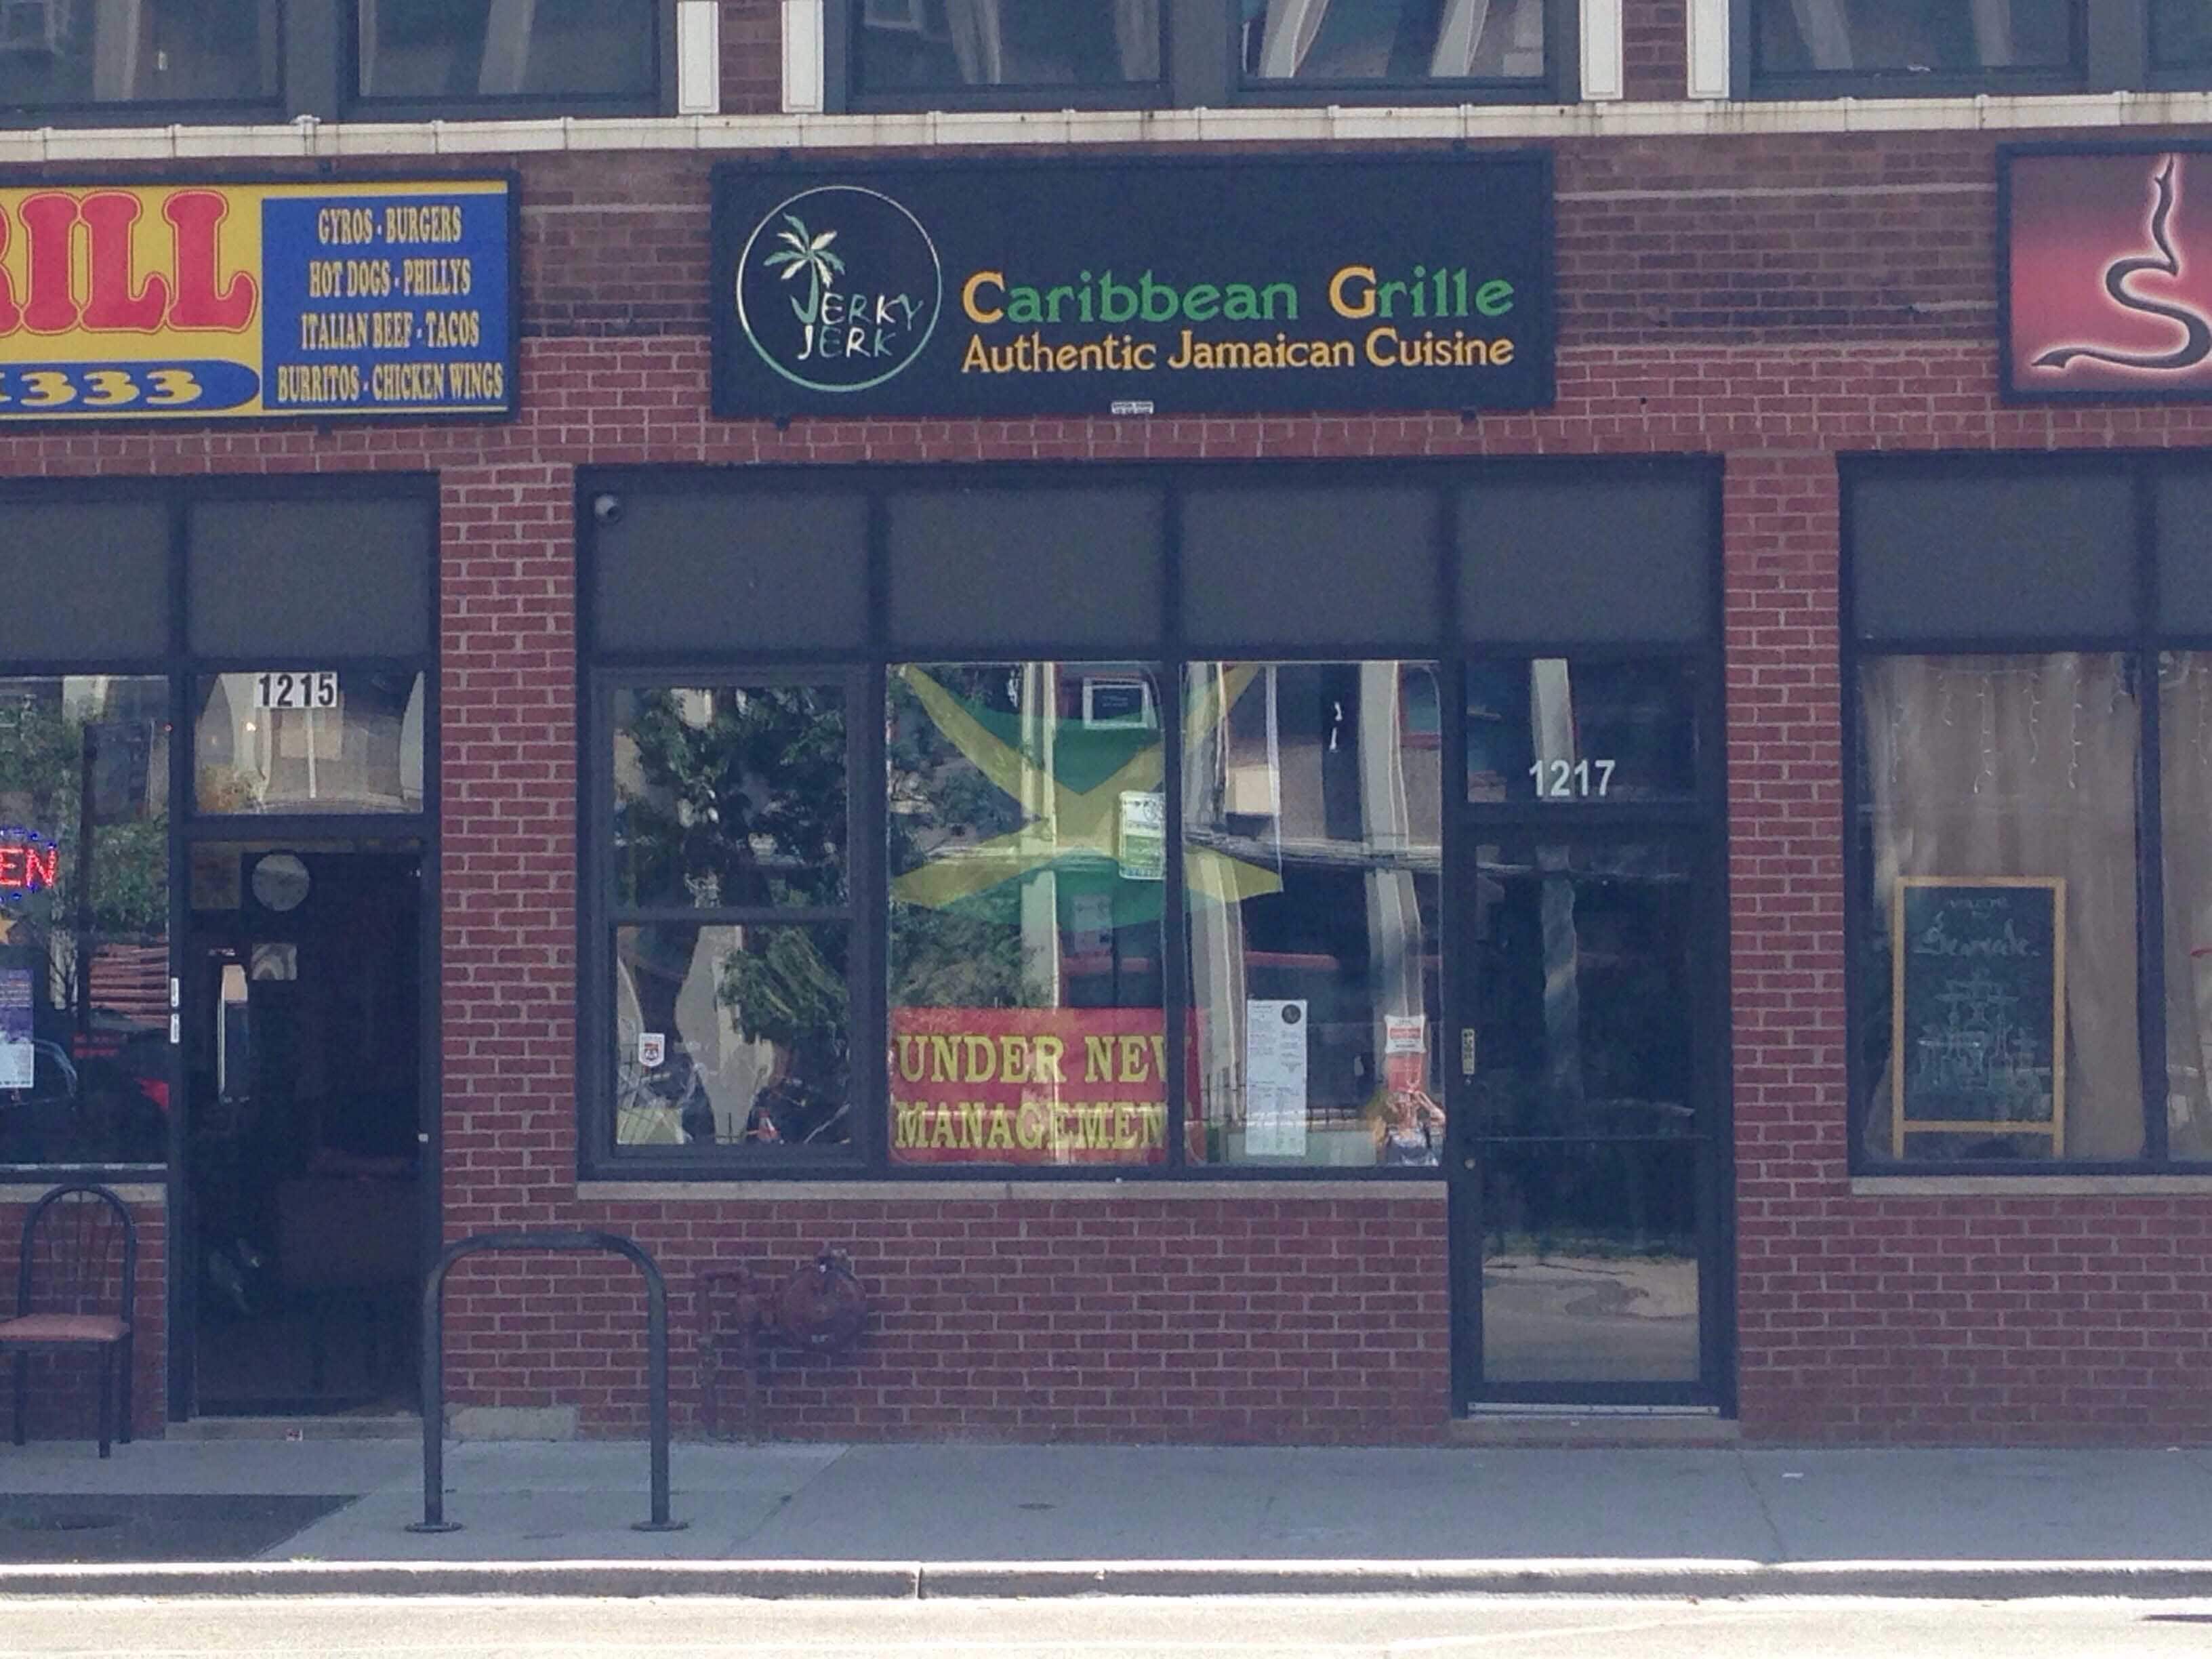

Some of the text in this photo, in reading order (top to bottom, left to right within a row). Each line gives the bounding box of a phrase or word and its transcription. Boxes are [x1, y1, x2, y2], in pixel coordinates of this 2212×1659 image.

[318, 205, 462, 245] GYROS BURGERS
[0, 190, 258, 337] ILL
[309, 258, 471, 298] HOT DOGS PHILLYS
[962, 264, 1515, 324] Caribbean Grille
[301, 310, 479, 350] ITALIAN BEEF TACOS
[798, 324, 897, 360] JERK
[961, 326, 1515, 373] Authentic Jamaican Cuisine
[0, 369, 203, 405] 333
[277, 362, 504, 403] BURRITOS CHICKEN WINGS
[259, 674, 334, 707] 1215
[1529, 759, 1616, 797] 1217
[895, 1033, 1067, 1084] UNDER
[894, 1101, 1168, 1151] MANAGEMEN
